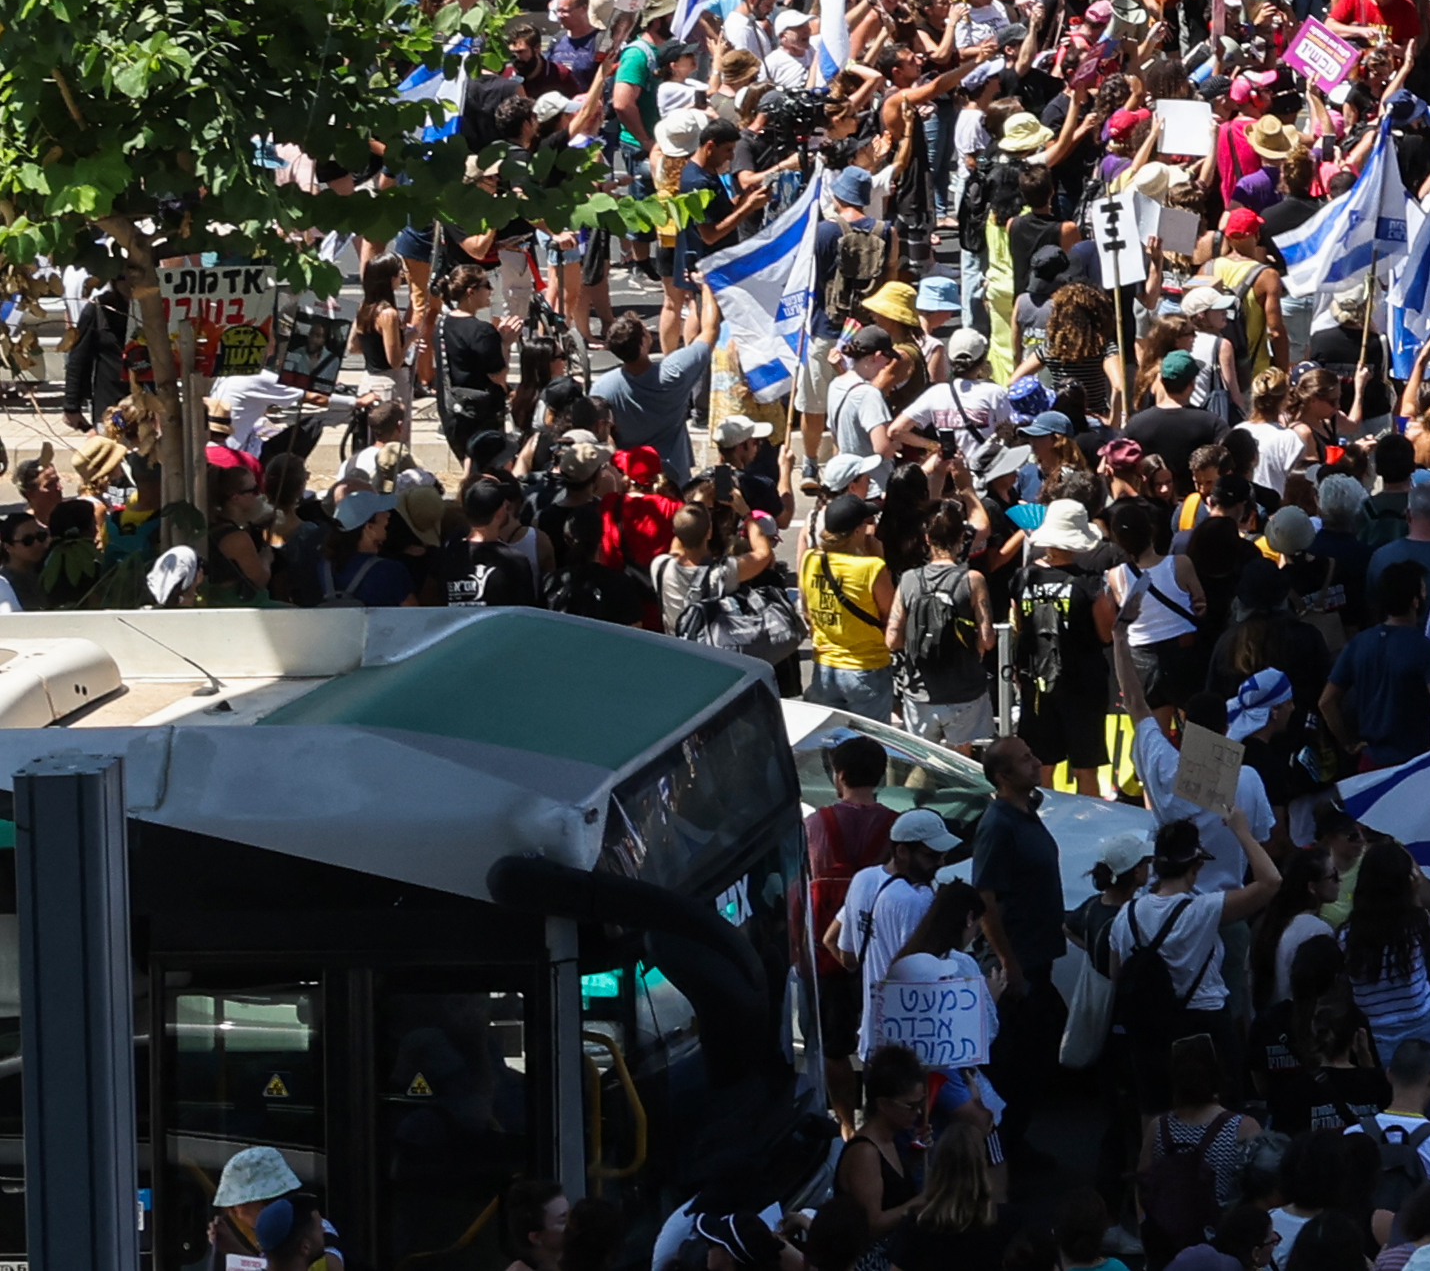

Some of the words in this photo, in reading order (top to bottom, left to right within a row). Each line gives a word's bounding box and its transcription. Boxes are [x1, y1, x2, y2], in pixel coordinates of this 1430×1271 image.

[163, 267, 266, 296] אדמתי
[899, 987, 978, 1014] כמעט
[883, 1016, 953, 1041] אבדה
